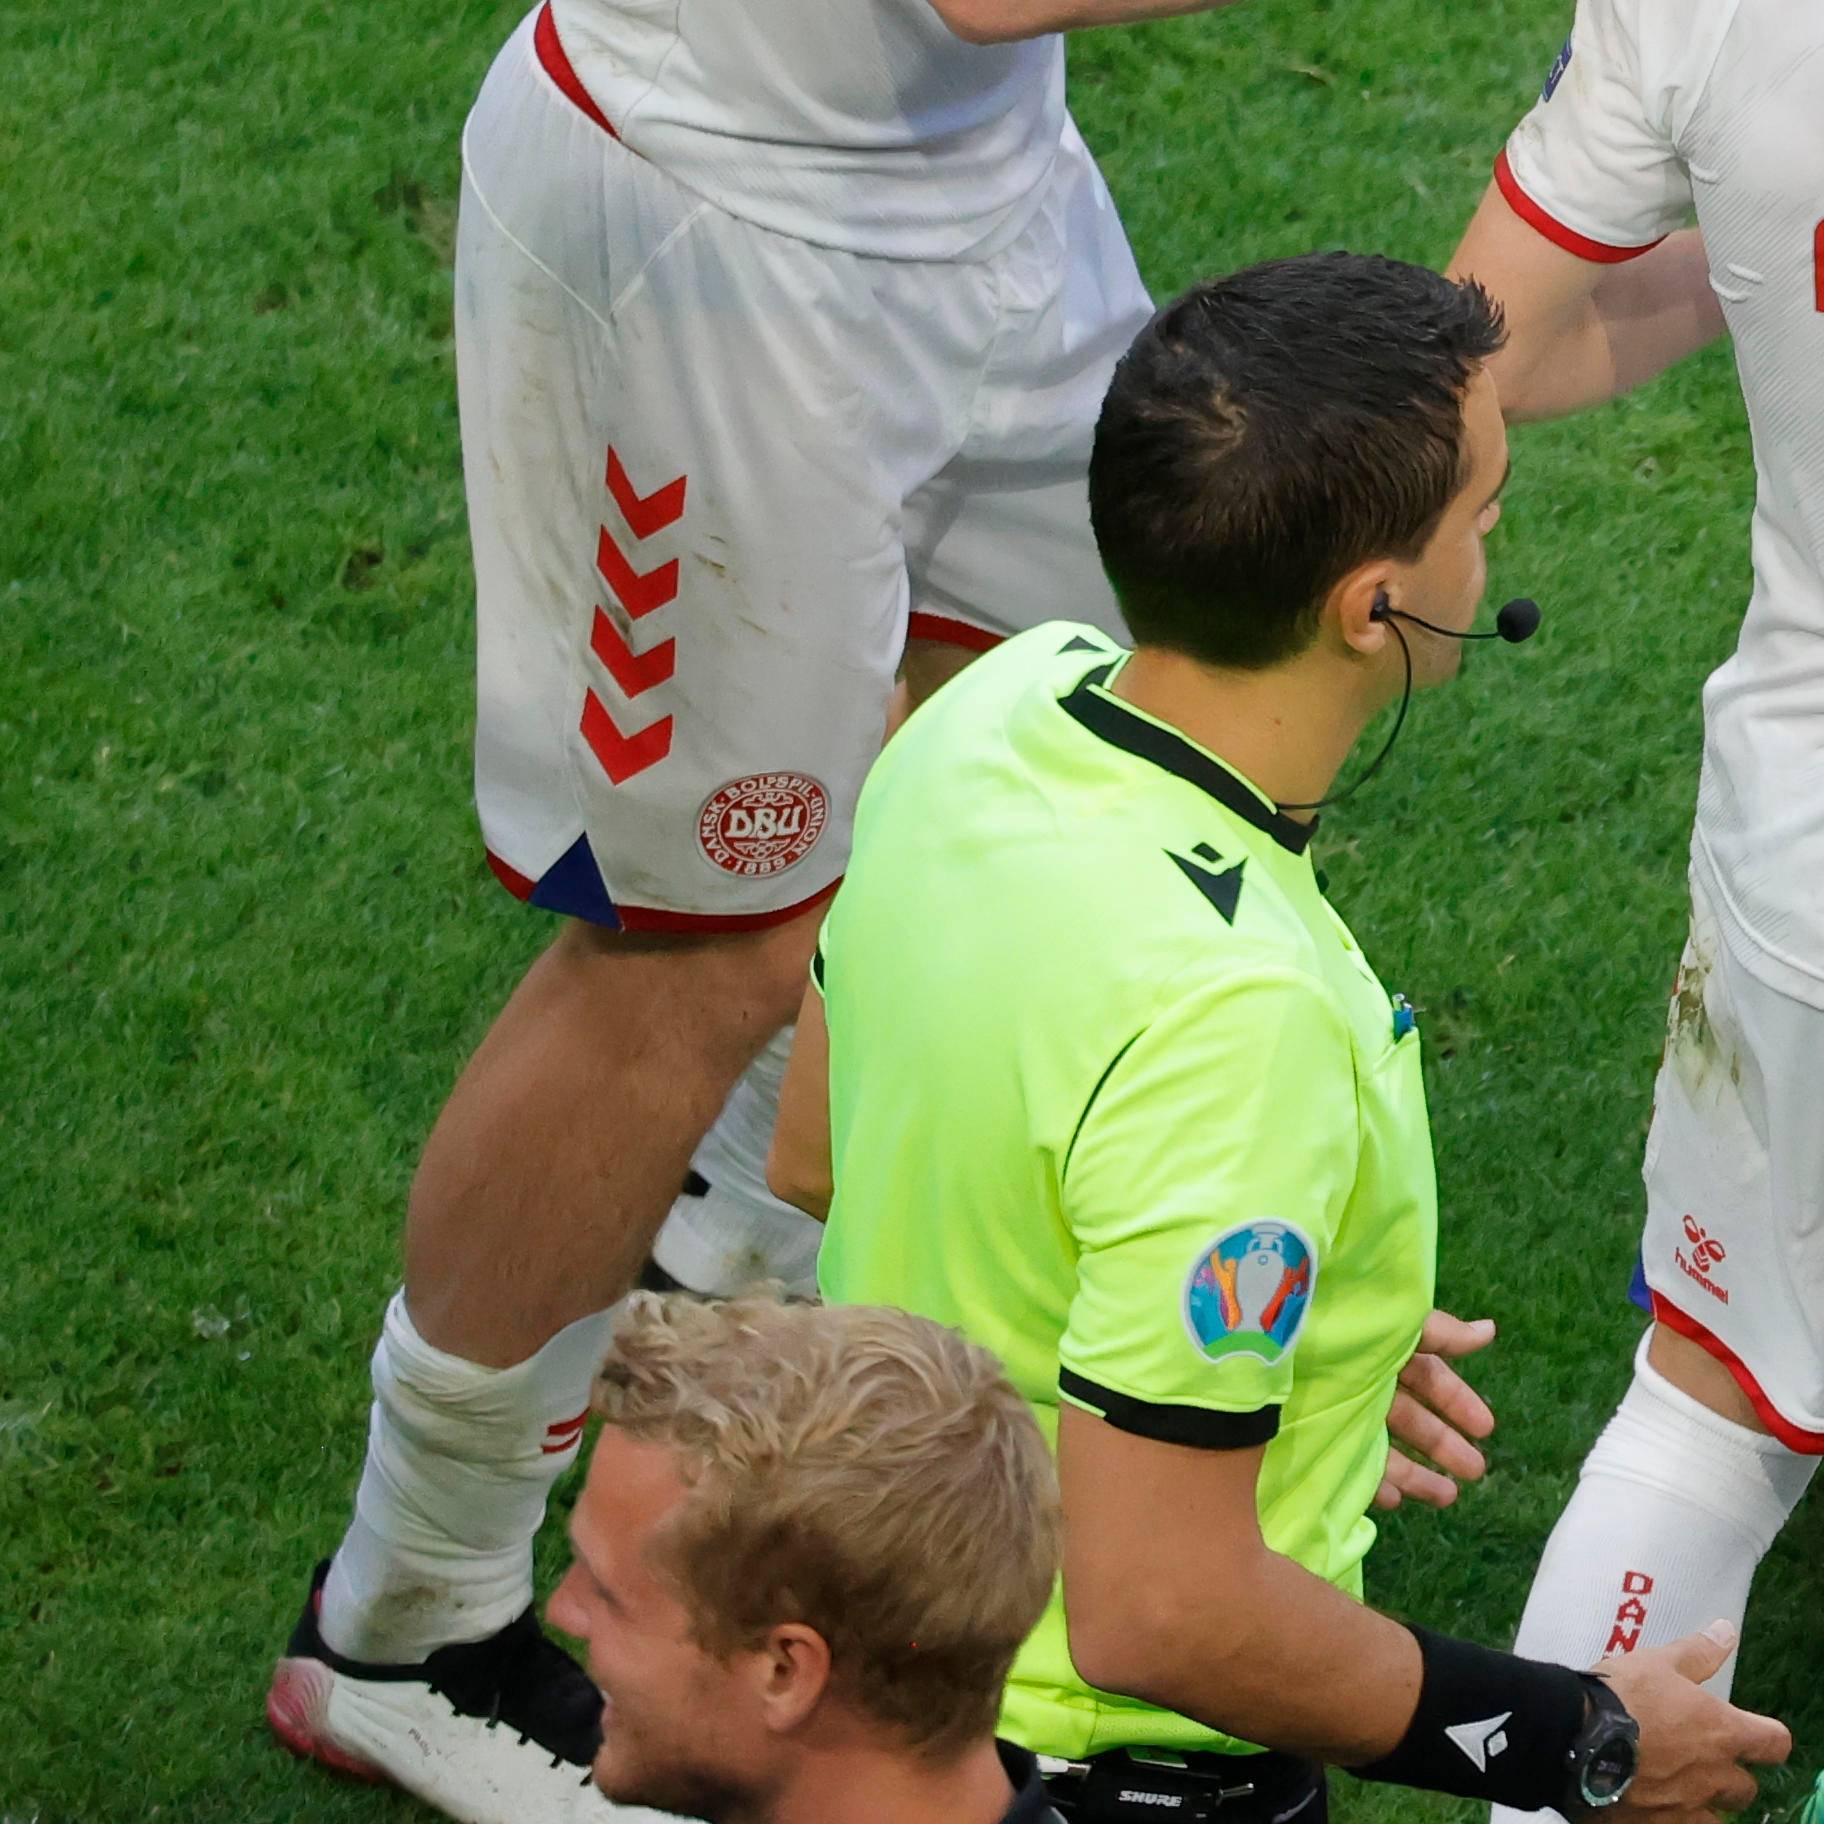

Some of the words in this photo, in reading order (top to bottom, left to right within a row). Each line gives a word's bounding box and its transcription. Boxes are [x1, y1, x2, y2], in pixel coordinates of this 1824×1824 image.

[702, 800, 730, 864] DANSK
[724, 805, 804, 840] DBU
[789, 795, 826, 857] UNION
[732, 856, 787, 875] 1889
[1674, 1246, 1729, 1306] hummel
[1602, 1570, 1654, 1660] DAN
[1117, 1789, 1183, 1808] SHURE
